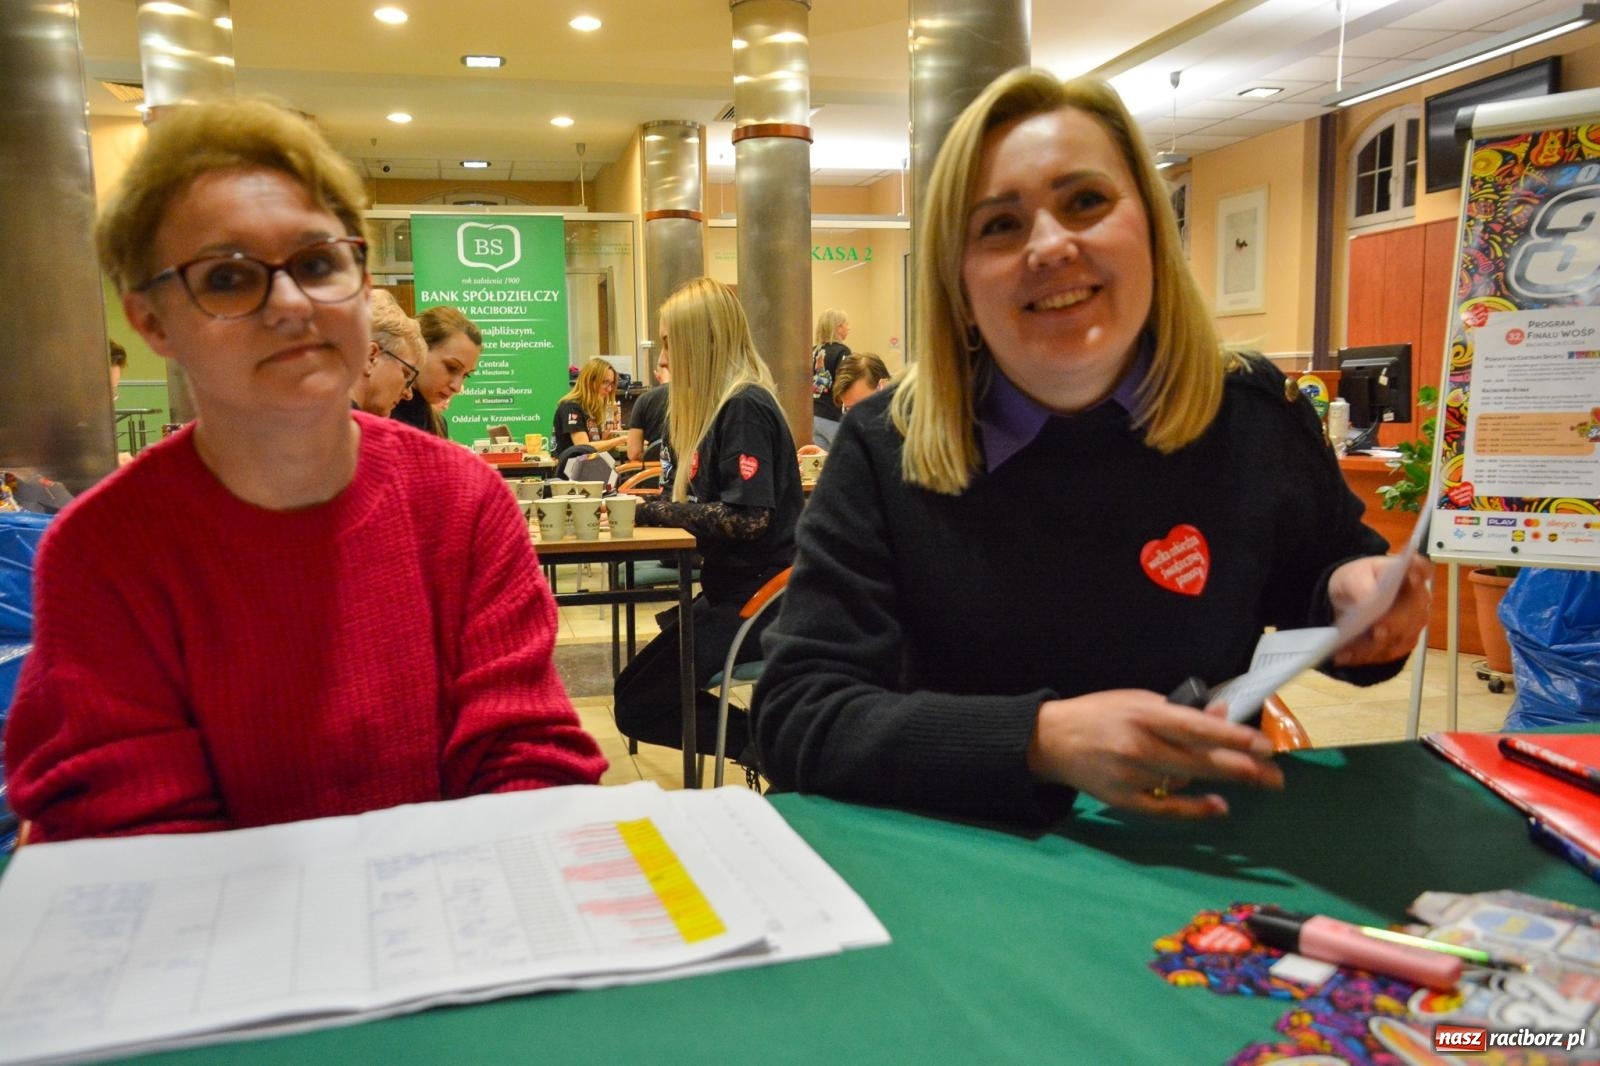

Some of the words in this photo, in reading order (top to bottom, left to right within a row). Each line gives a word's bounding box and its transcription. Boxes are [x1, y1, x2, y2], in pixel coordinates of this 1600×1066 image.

[474, 238, 504, 256] BS
[811, 246, 859, 261] KASA
[864, 247, 873, 261] 2
[504, 277, 520, 285] 1900
[421, 290, 459, 302] BANK
[462, 288, 560, 302] SPÓŁDZIELCZY
[457, 305, 467, 315] W
[470, 305, 528, 315] RACIBORZU
[481, 326, 536, 337] najbliższym.
[1561, 327, 1595, 338] WOŚP
[499, 339, 555, 350] bezpiecznie.
[478, 360, 509, 368] Centrala
[496, 387, 533, 395] Raciborzu
[452, 415, 481, 423] Oddział
[490, 414, 541, 422] Krzanowicach
[1488, 518, 1516, 526] PLAY
